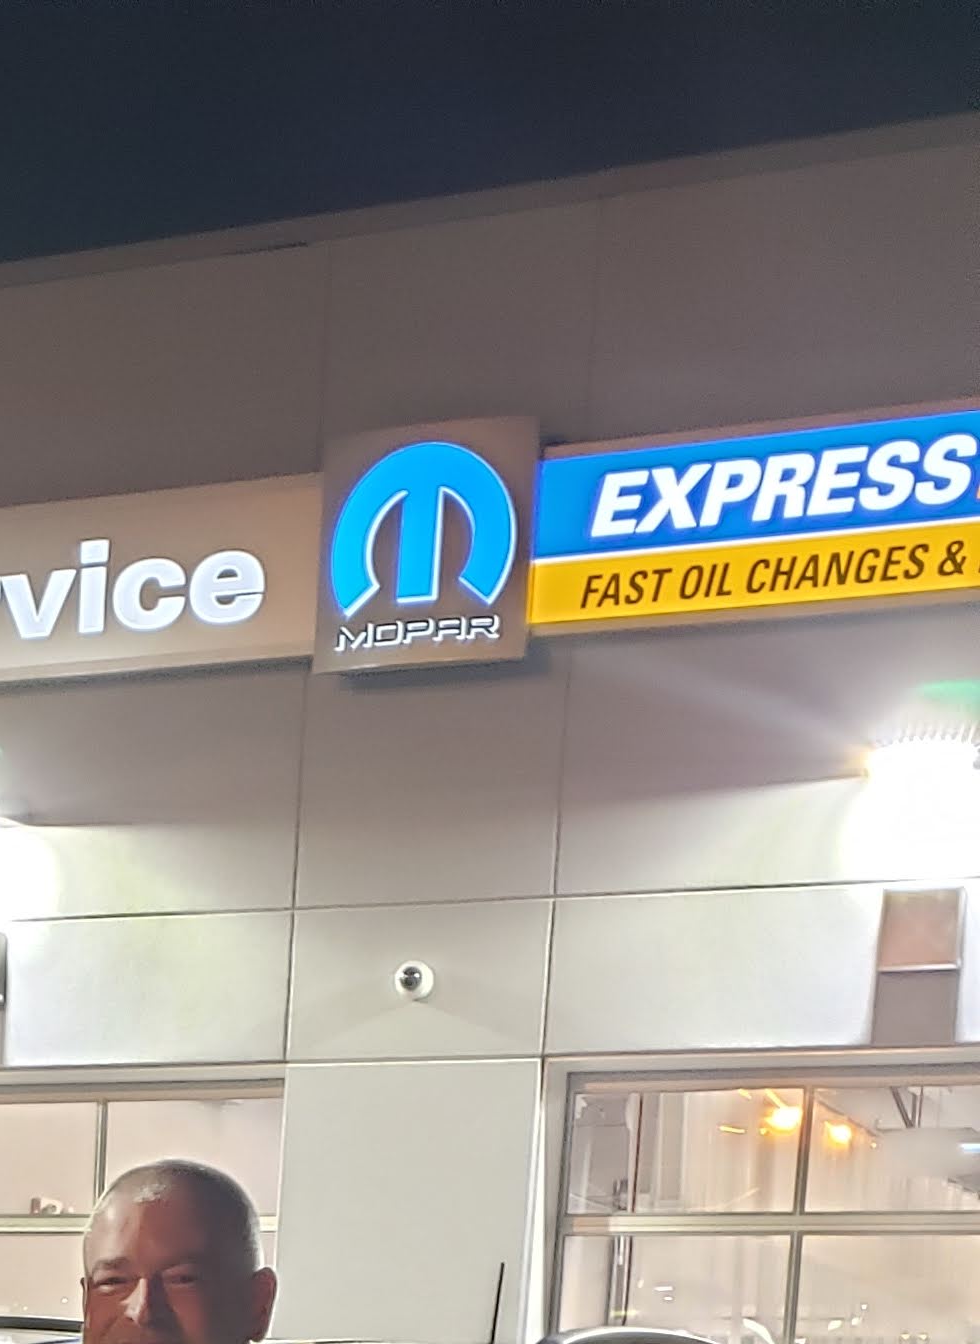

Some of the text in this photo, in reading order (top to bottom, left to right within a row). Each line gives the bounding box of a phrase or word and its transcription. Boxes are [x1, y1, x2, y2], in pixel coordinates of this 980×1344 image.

[591, 433, 977, 538] EXPRESS
[579, 540, 967, 609] FAST OIL CHANGES &
[332, 613, 500, 652] MOPAR
